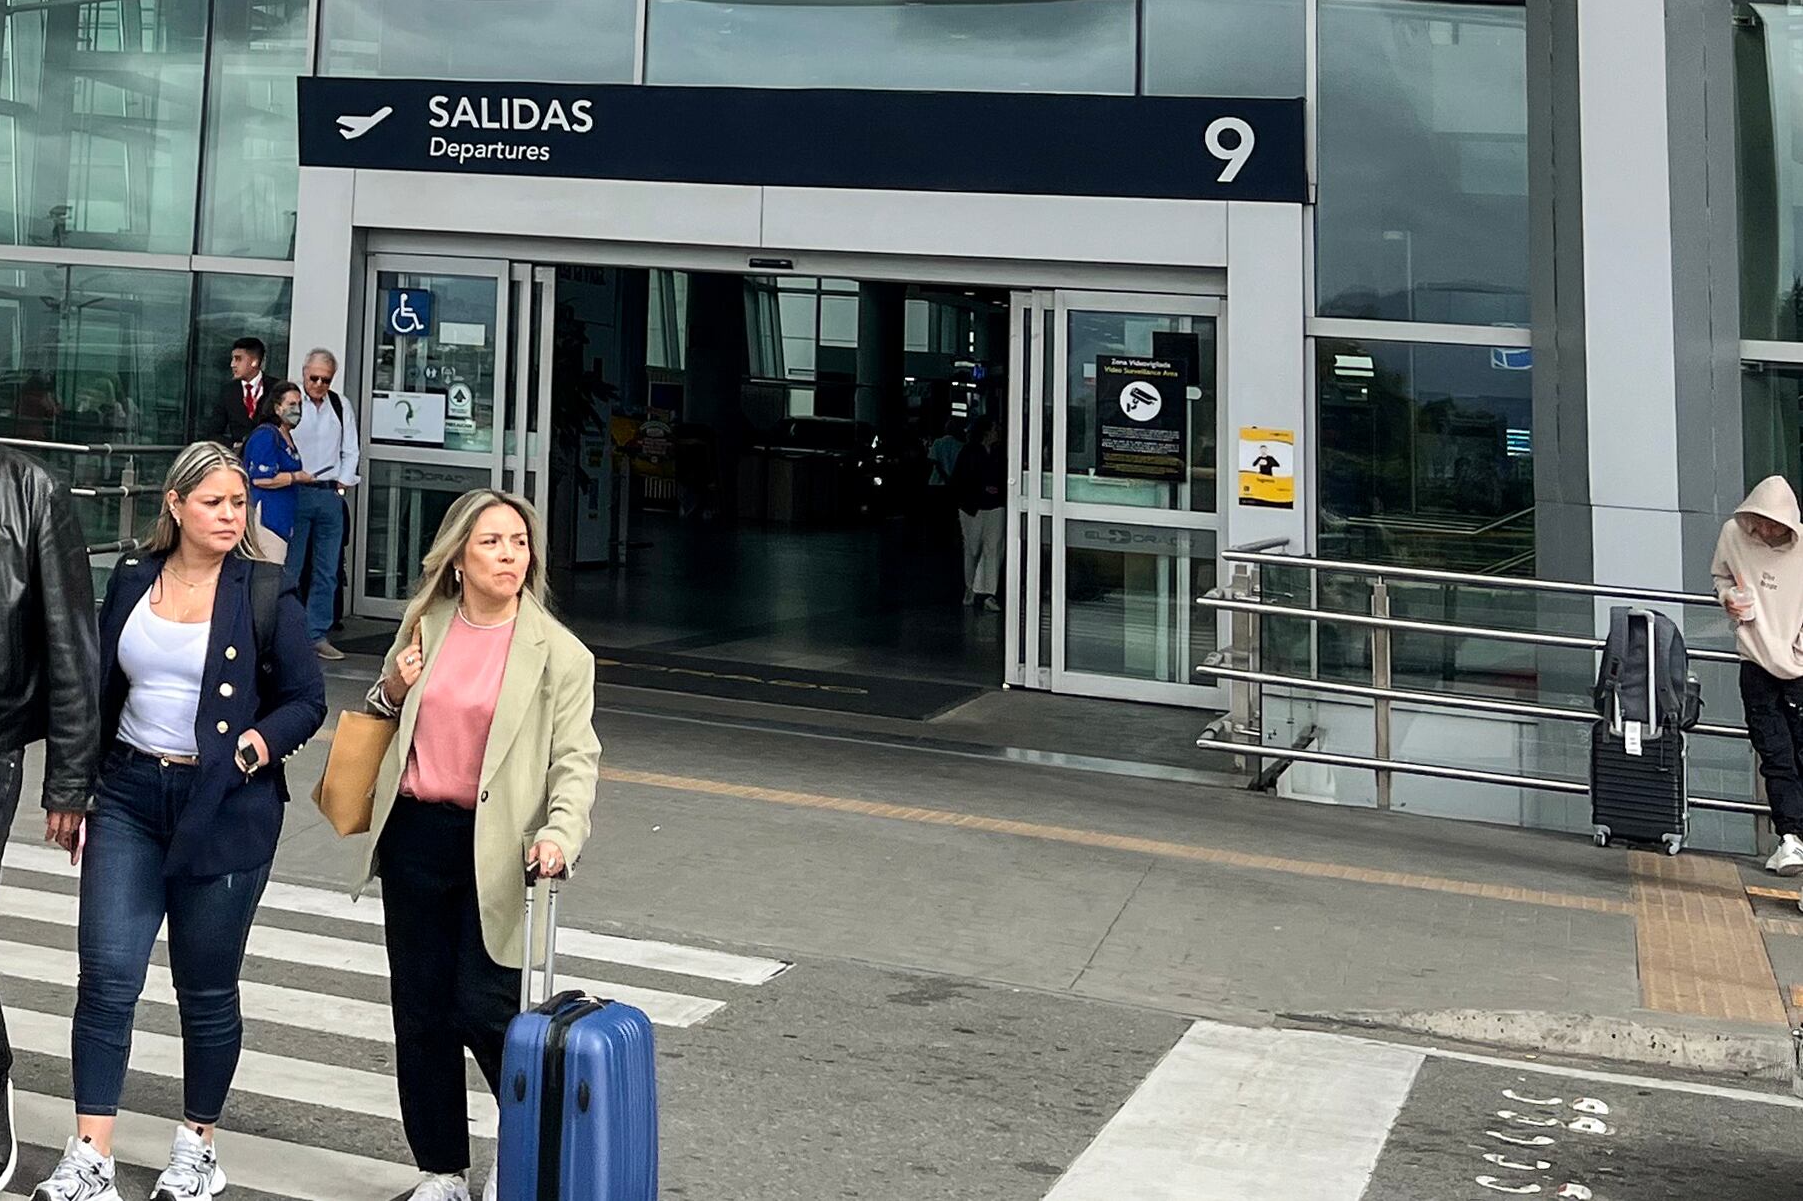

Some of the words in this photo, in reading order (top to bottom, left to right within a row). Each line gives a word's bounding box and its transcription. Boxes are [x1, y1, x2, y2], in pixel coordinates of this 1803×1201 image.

[428, 95, 593, 133] SALIDAS
[429, 136, 550, 165] Departures
[1204, 116, 1255, 182] 9
